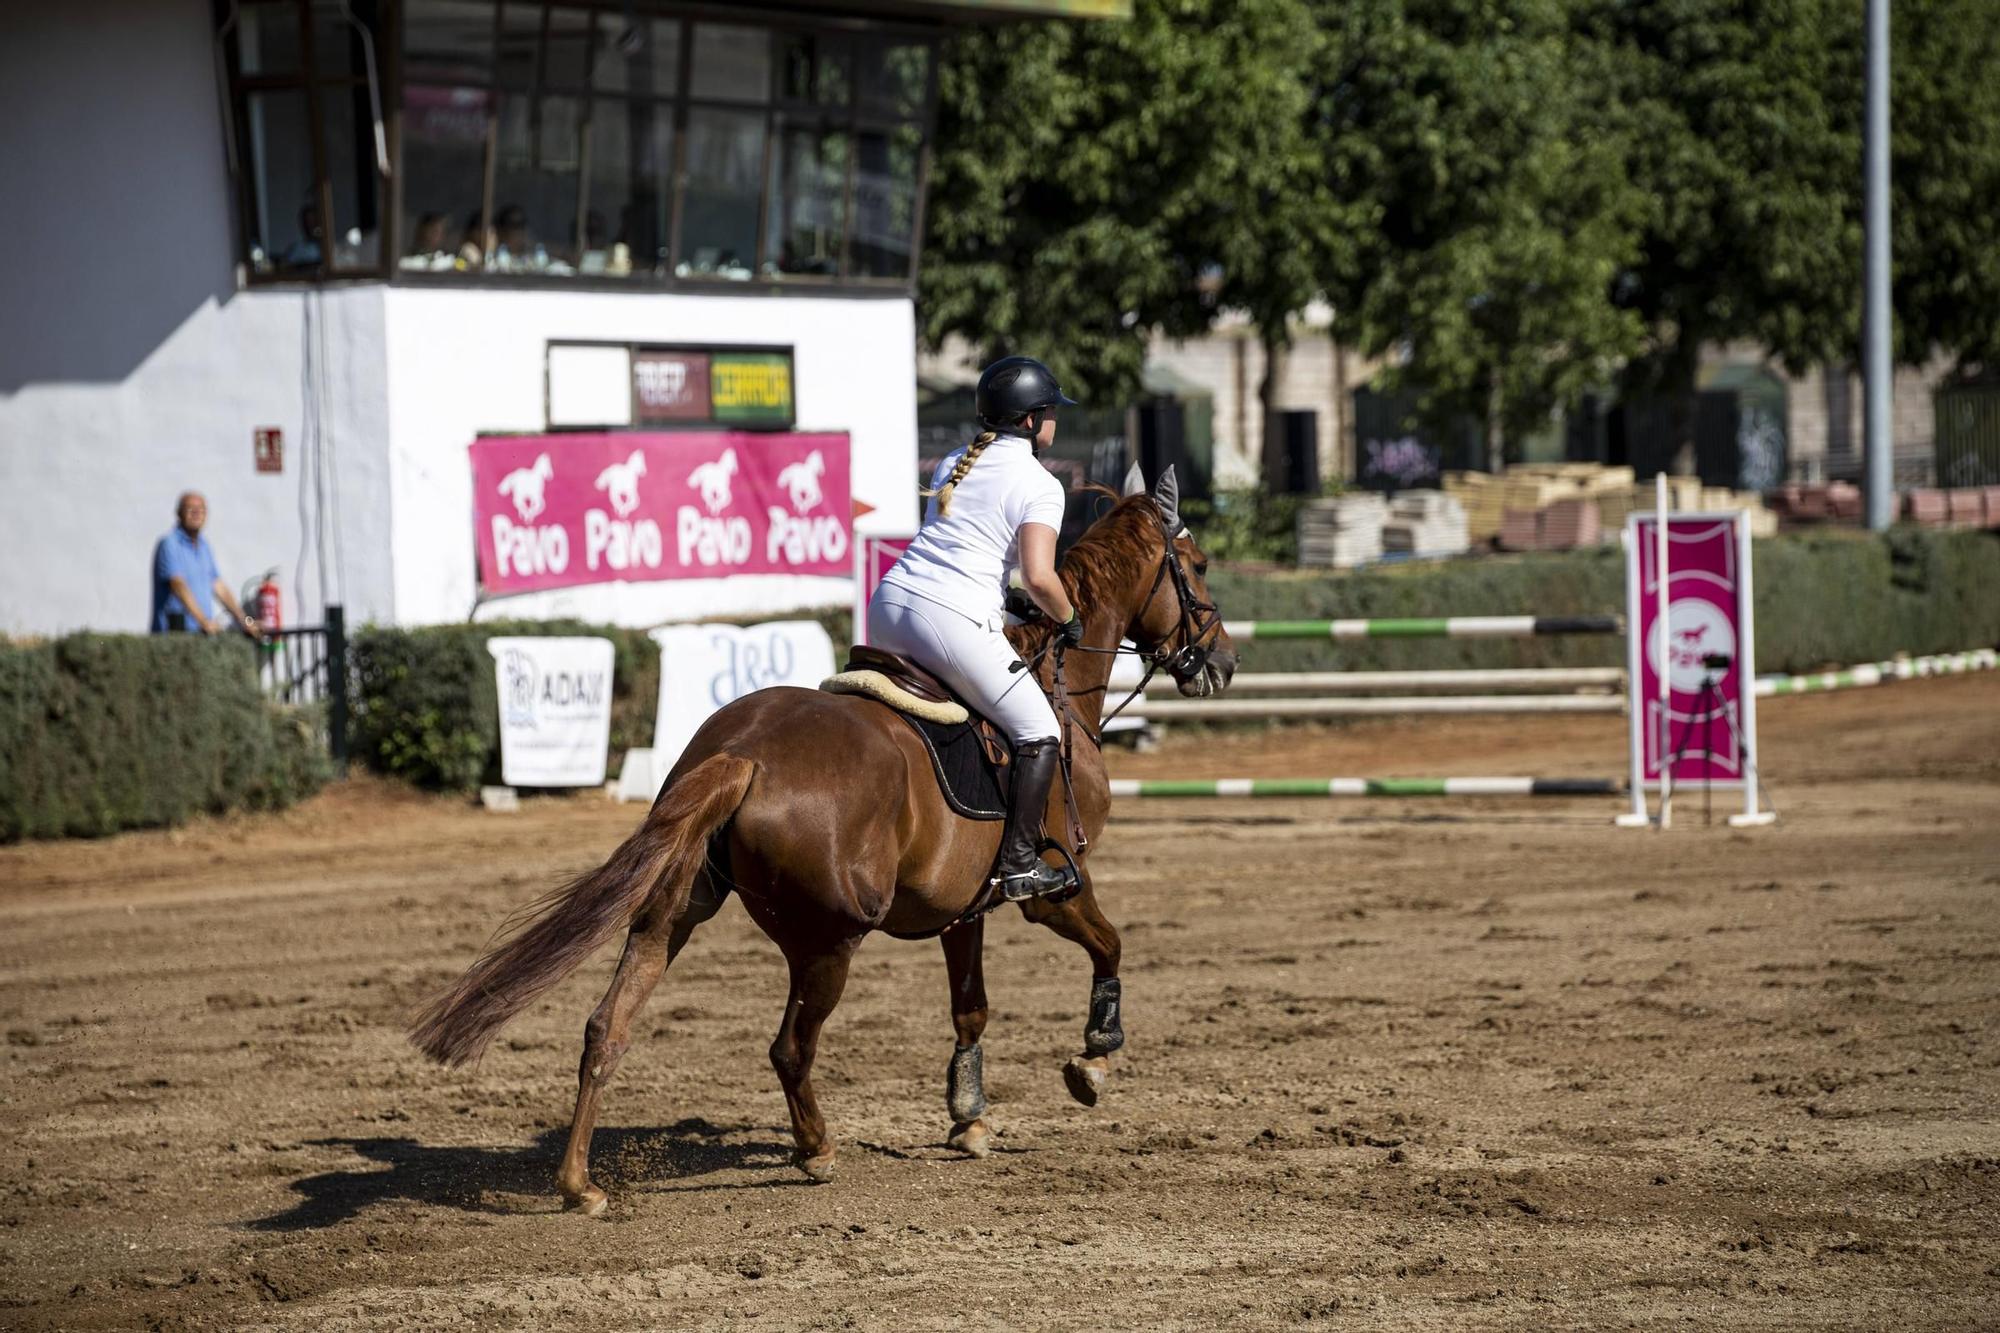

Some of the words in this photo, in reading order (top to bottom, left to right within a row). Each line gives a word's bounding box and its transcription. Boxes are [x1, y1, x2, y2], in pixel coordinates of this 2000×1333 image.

[491, 515, 569, 577] Pavo
[586, 509, 662, 571] Pavo
[677, 505, 752, 567] Pavo
[767, 506, 848, 565] Pavo
